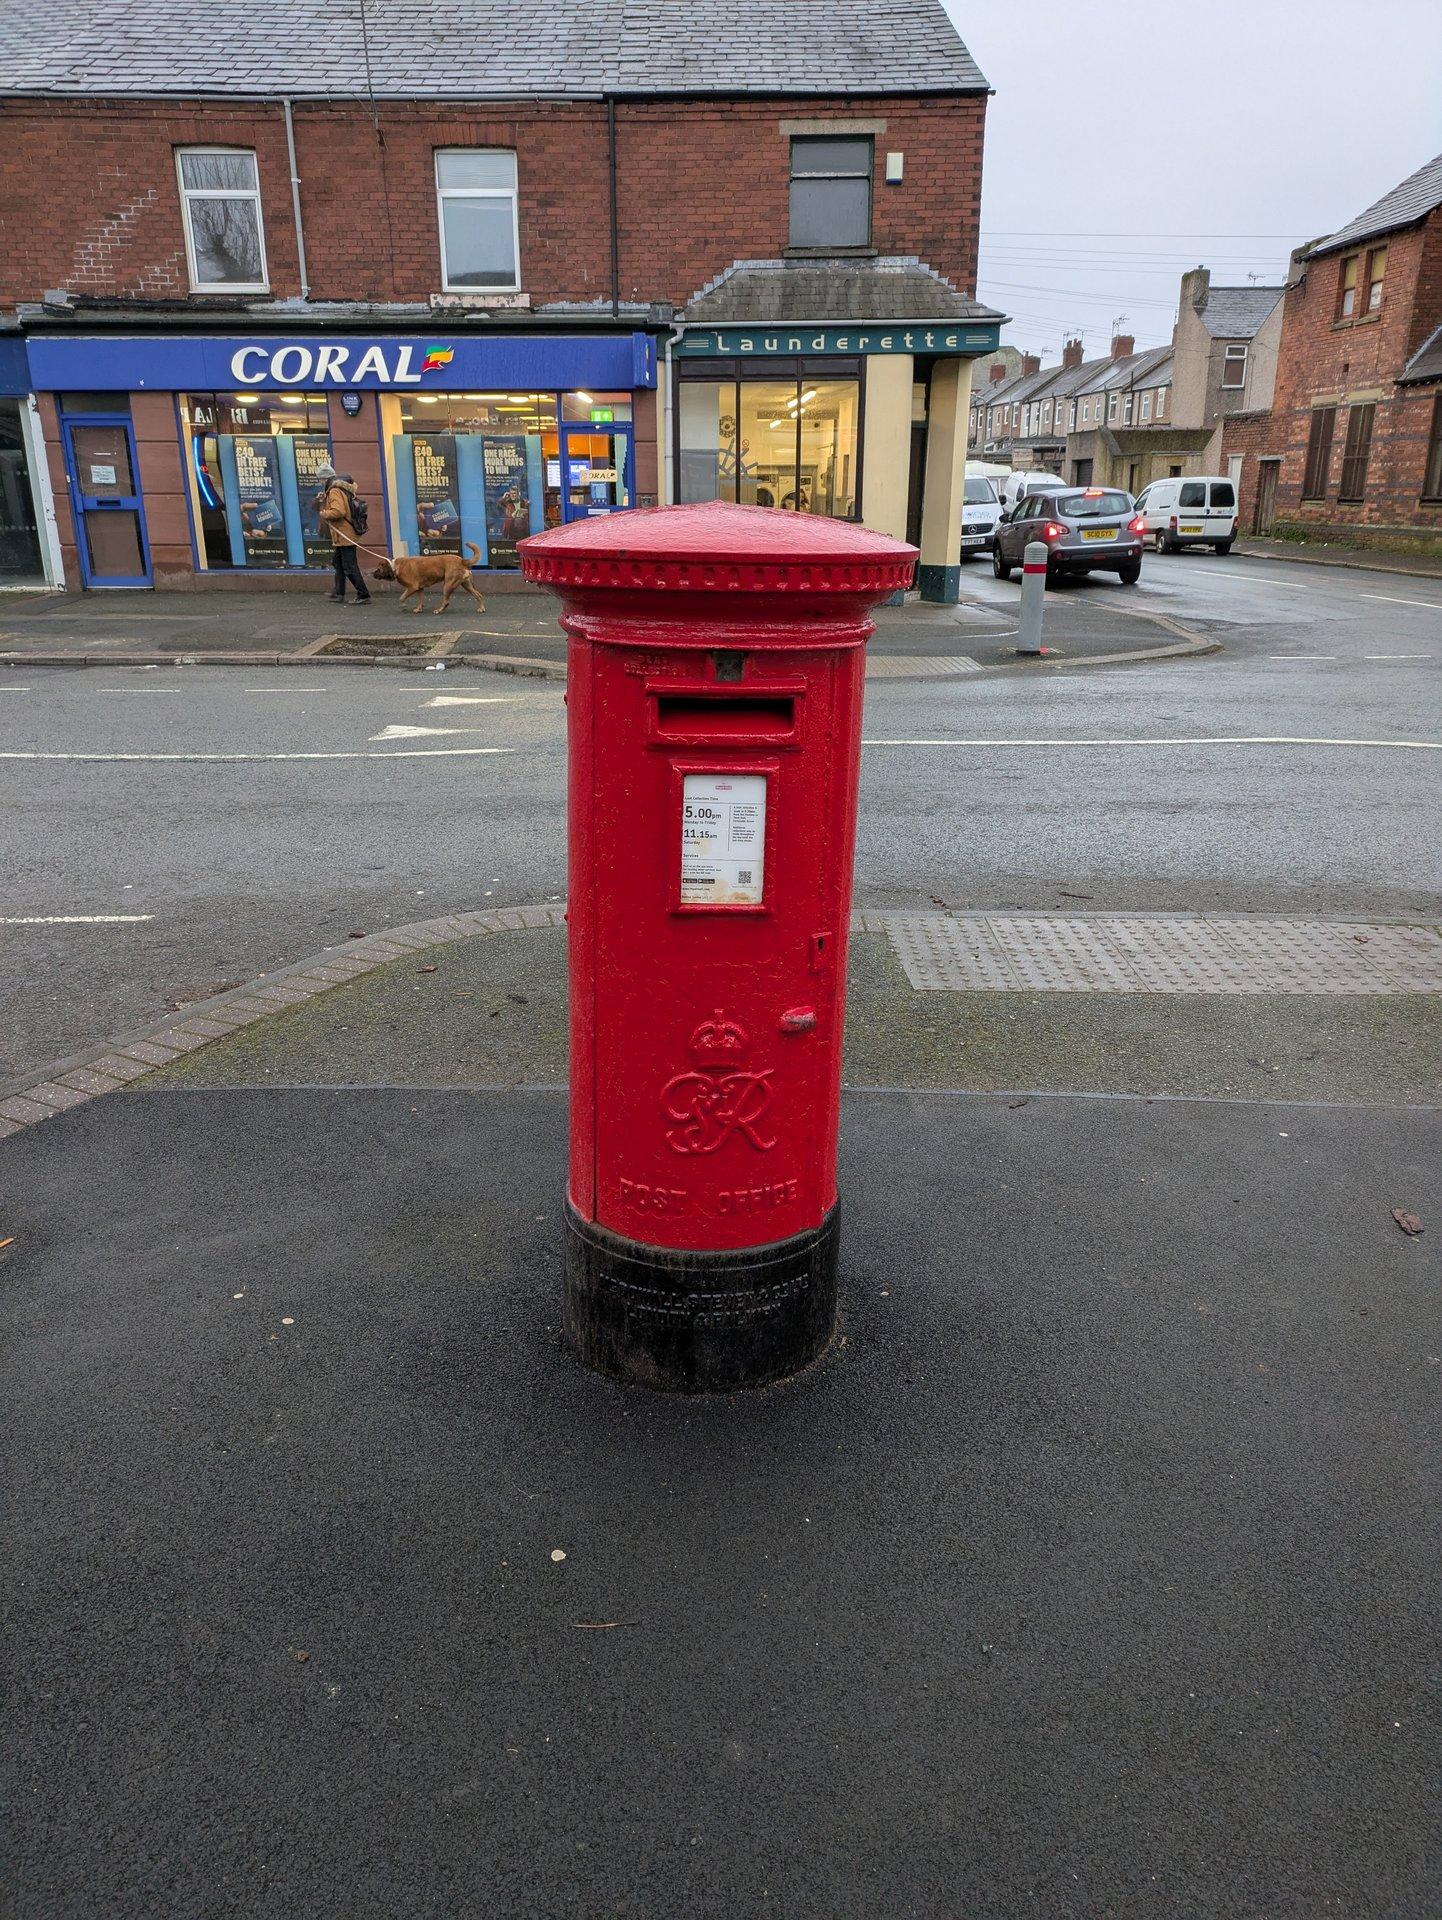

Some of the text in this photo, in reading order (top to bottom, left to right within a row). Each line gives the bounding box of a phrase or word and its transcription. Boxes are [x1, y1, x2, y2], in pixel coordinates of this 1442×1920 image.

[717, 332, 957, 352] Launderette
[231, 346, 422, 383] CORAL
[236, 446, 254, 457] £40
[295, 449, 310, 458] ONE
[414, 446, 432, 457] £40
[484, 449, 497, 457] ONE
[236, 457, 267, 467] IN FREE
[297, 458, 316, 466] MORE
[415, 456, 445, 467] IN FREE
[485, 457, 524, 466] MORE WAYS
[238, 467, 264, 477] BETS?
[298, 466, 308, 474] TO
[416, 466, 442, 476] BETS?
[486, 466, 509, 474] TO WIN
[239, 477, 272, 487] RESULT!
[417, 476, 449, 486] RESULT!
[685, 805, 722, 819] 5.00pm
[684, 829, 718, 839] 11.15am
[620, 1177, 798, 1213] POST OFFICE
